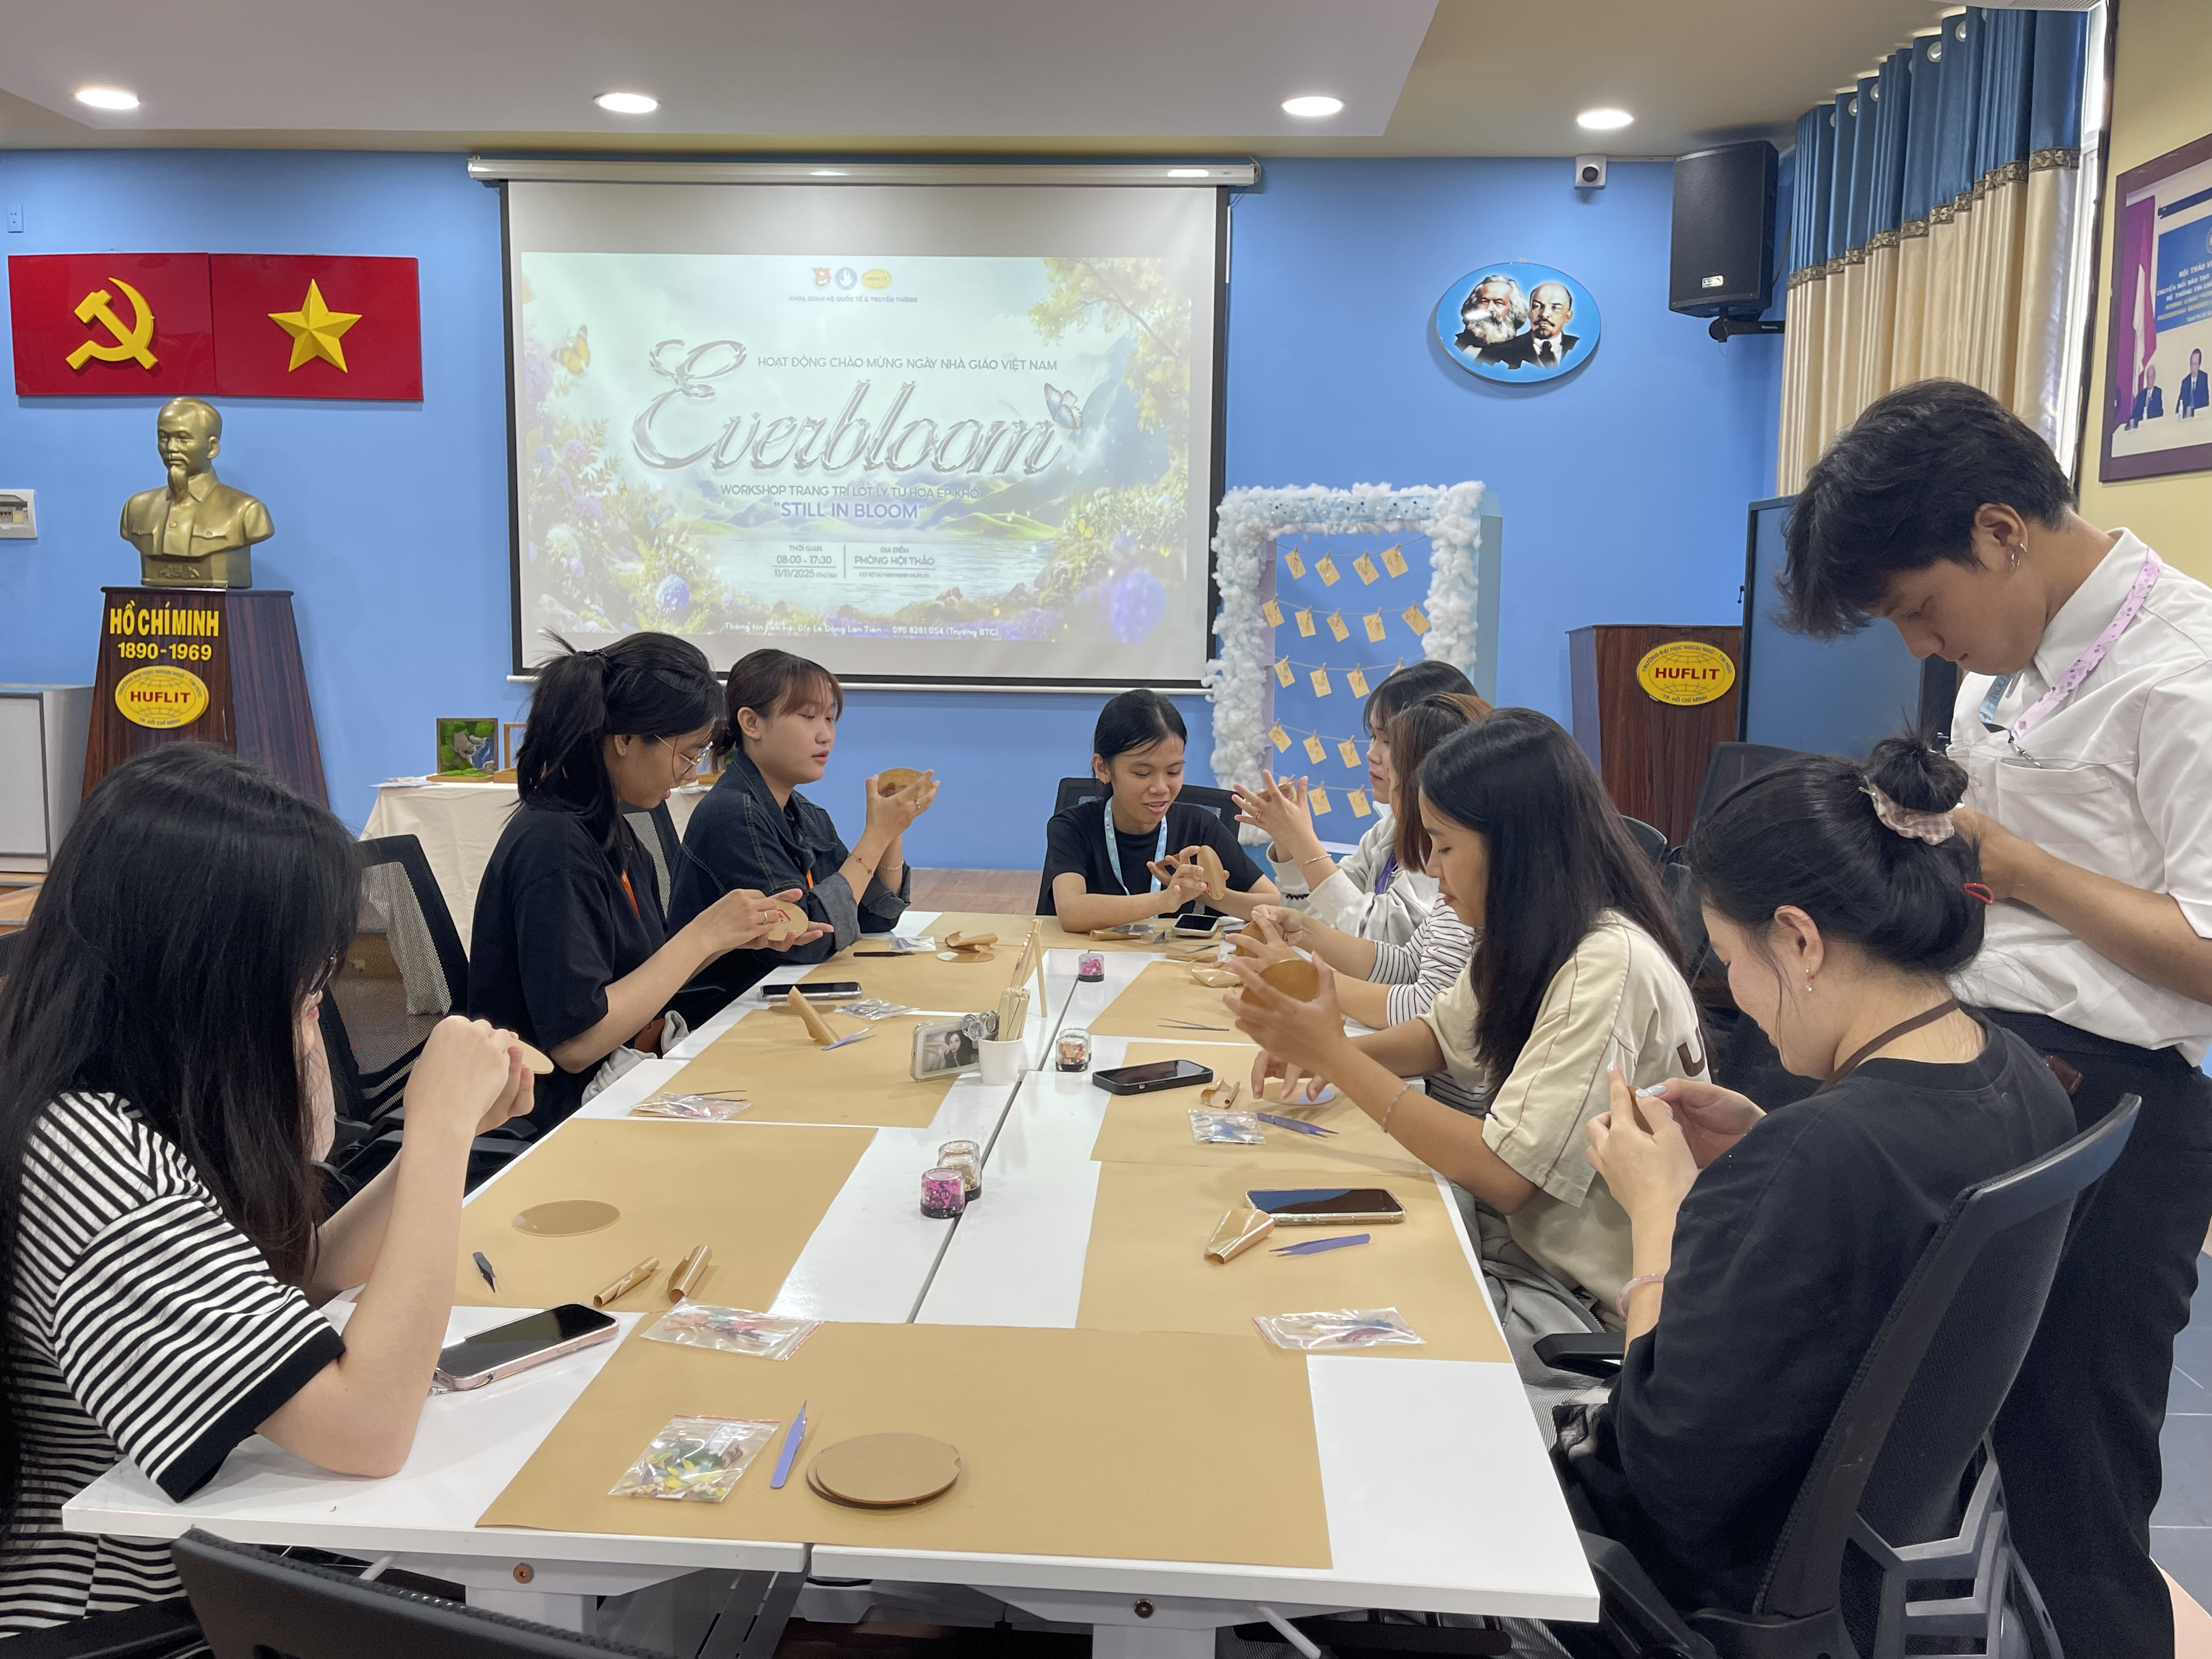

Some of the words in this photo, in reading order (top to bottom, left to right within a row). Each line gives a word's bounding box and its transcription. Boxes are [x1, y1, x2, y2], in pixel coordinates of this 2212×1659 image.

[758, 356, 788, 369] HOẠT
[791, 354, 827, 370] ĐỘNG
[830, 355, 864, 368] CHÀO
[867, 356, 904, 368] MỪNG
[907, 356, 938, 369] NGÀY
[940, 357, 966, 369] NHÀ
[968, 357, 998, 370] GIÁO
[1001, 357, 1027, 372] VIỆT
[1029, 359, 1058, 370] NAM
[633, 337, 1063, 476] Everbloom
[720, 484, 787, 495] WORKSHOP
[788, 486, 830, 496] TRANG
[832, 484, 849, 496] TRÍ
[853, 484, 873, 496] LÓT
[877, 487, 889, 496] LY
[910, 488, 934, 498] HOA
[937, 486, 951, 498] ÉP
[955, 486, 979, 499] KHÔ
[774, 501, 826, 517] "STILL
[831, 503, 849, 517] IN
[855, 503, 926, 519] BLOOM"
[776, 555, 802, 563] 08:00
[809, 555, 832, 564] 17:30
[854, 555, 889, 565] PHÒNG
[890, 555, 907, 567] HỘI
[909, 555, 935, 566] THẢO
[774, 568, 815, 578] 11/11/2025
[110, 600, 136, 636] HỒ
[137, 601, 171, 636] CHÍ
[172, 609, 219, 637] MINH
[929, 627, 944, 635] 054
[979, 628, 998, 636] BTC)
[1655, 667, 1720, 680] HUFLIT
[130, 691, 191, 703] HUFLIT
